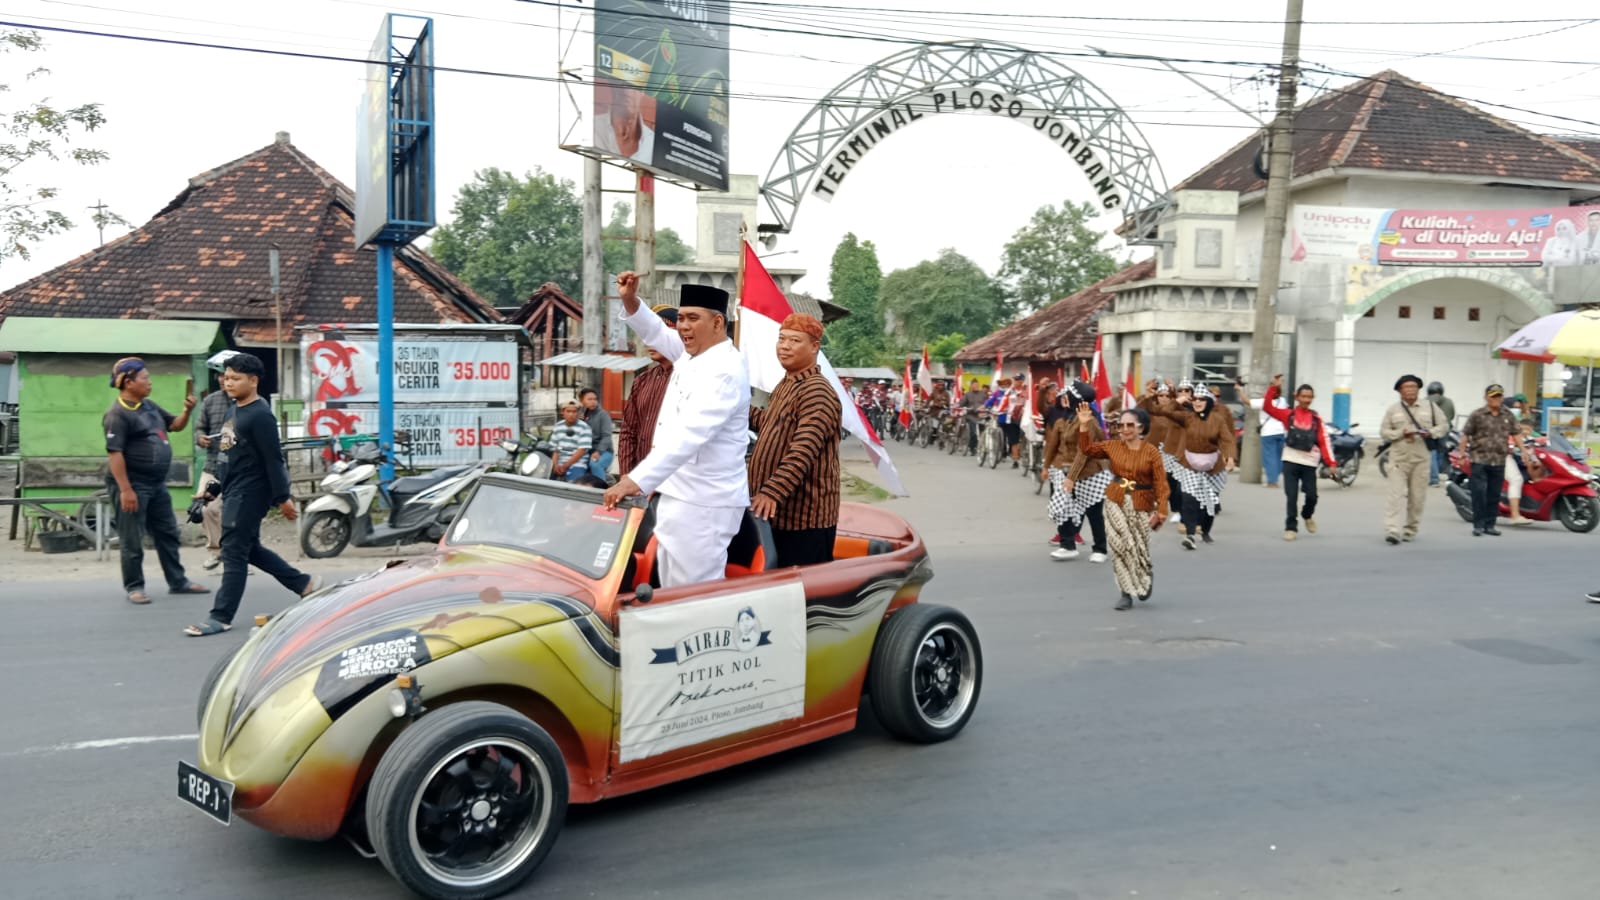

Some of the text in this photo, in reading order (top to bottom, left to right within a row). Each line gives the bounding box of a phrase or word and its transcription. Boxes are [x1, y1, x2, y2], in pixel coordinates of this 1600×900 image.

[600, 53, 612, 68] 12
[814, 103, 923, 197] TERMINAL
[933, 90, 1024, 118] PLOSO
[1034, 115, 1120, 211] JOMBANG
[1303, 212, 1371, 225] Unipdu
[1415, 230, 1432, 243] di
[1439, 230, 1501, 246] Unipdu
[1506, 230, 1544, 246] Aja!
[397, 347, 439, 359] 35 TAHUN
[453, 361, 511, 381] 35.000
[398, 376, 440, 389] CERITA
[400, 414, 441, 427] 35 TAHUN
[683, 630, 732, 657] KIRAB
[678, 656, 761, 686] TITIK NOL
